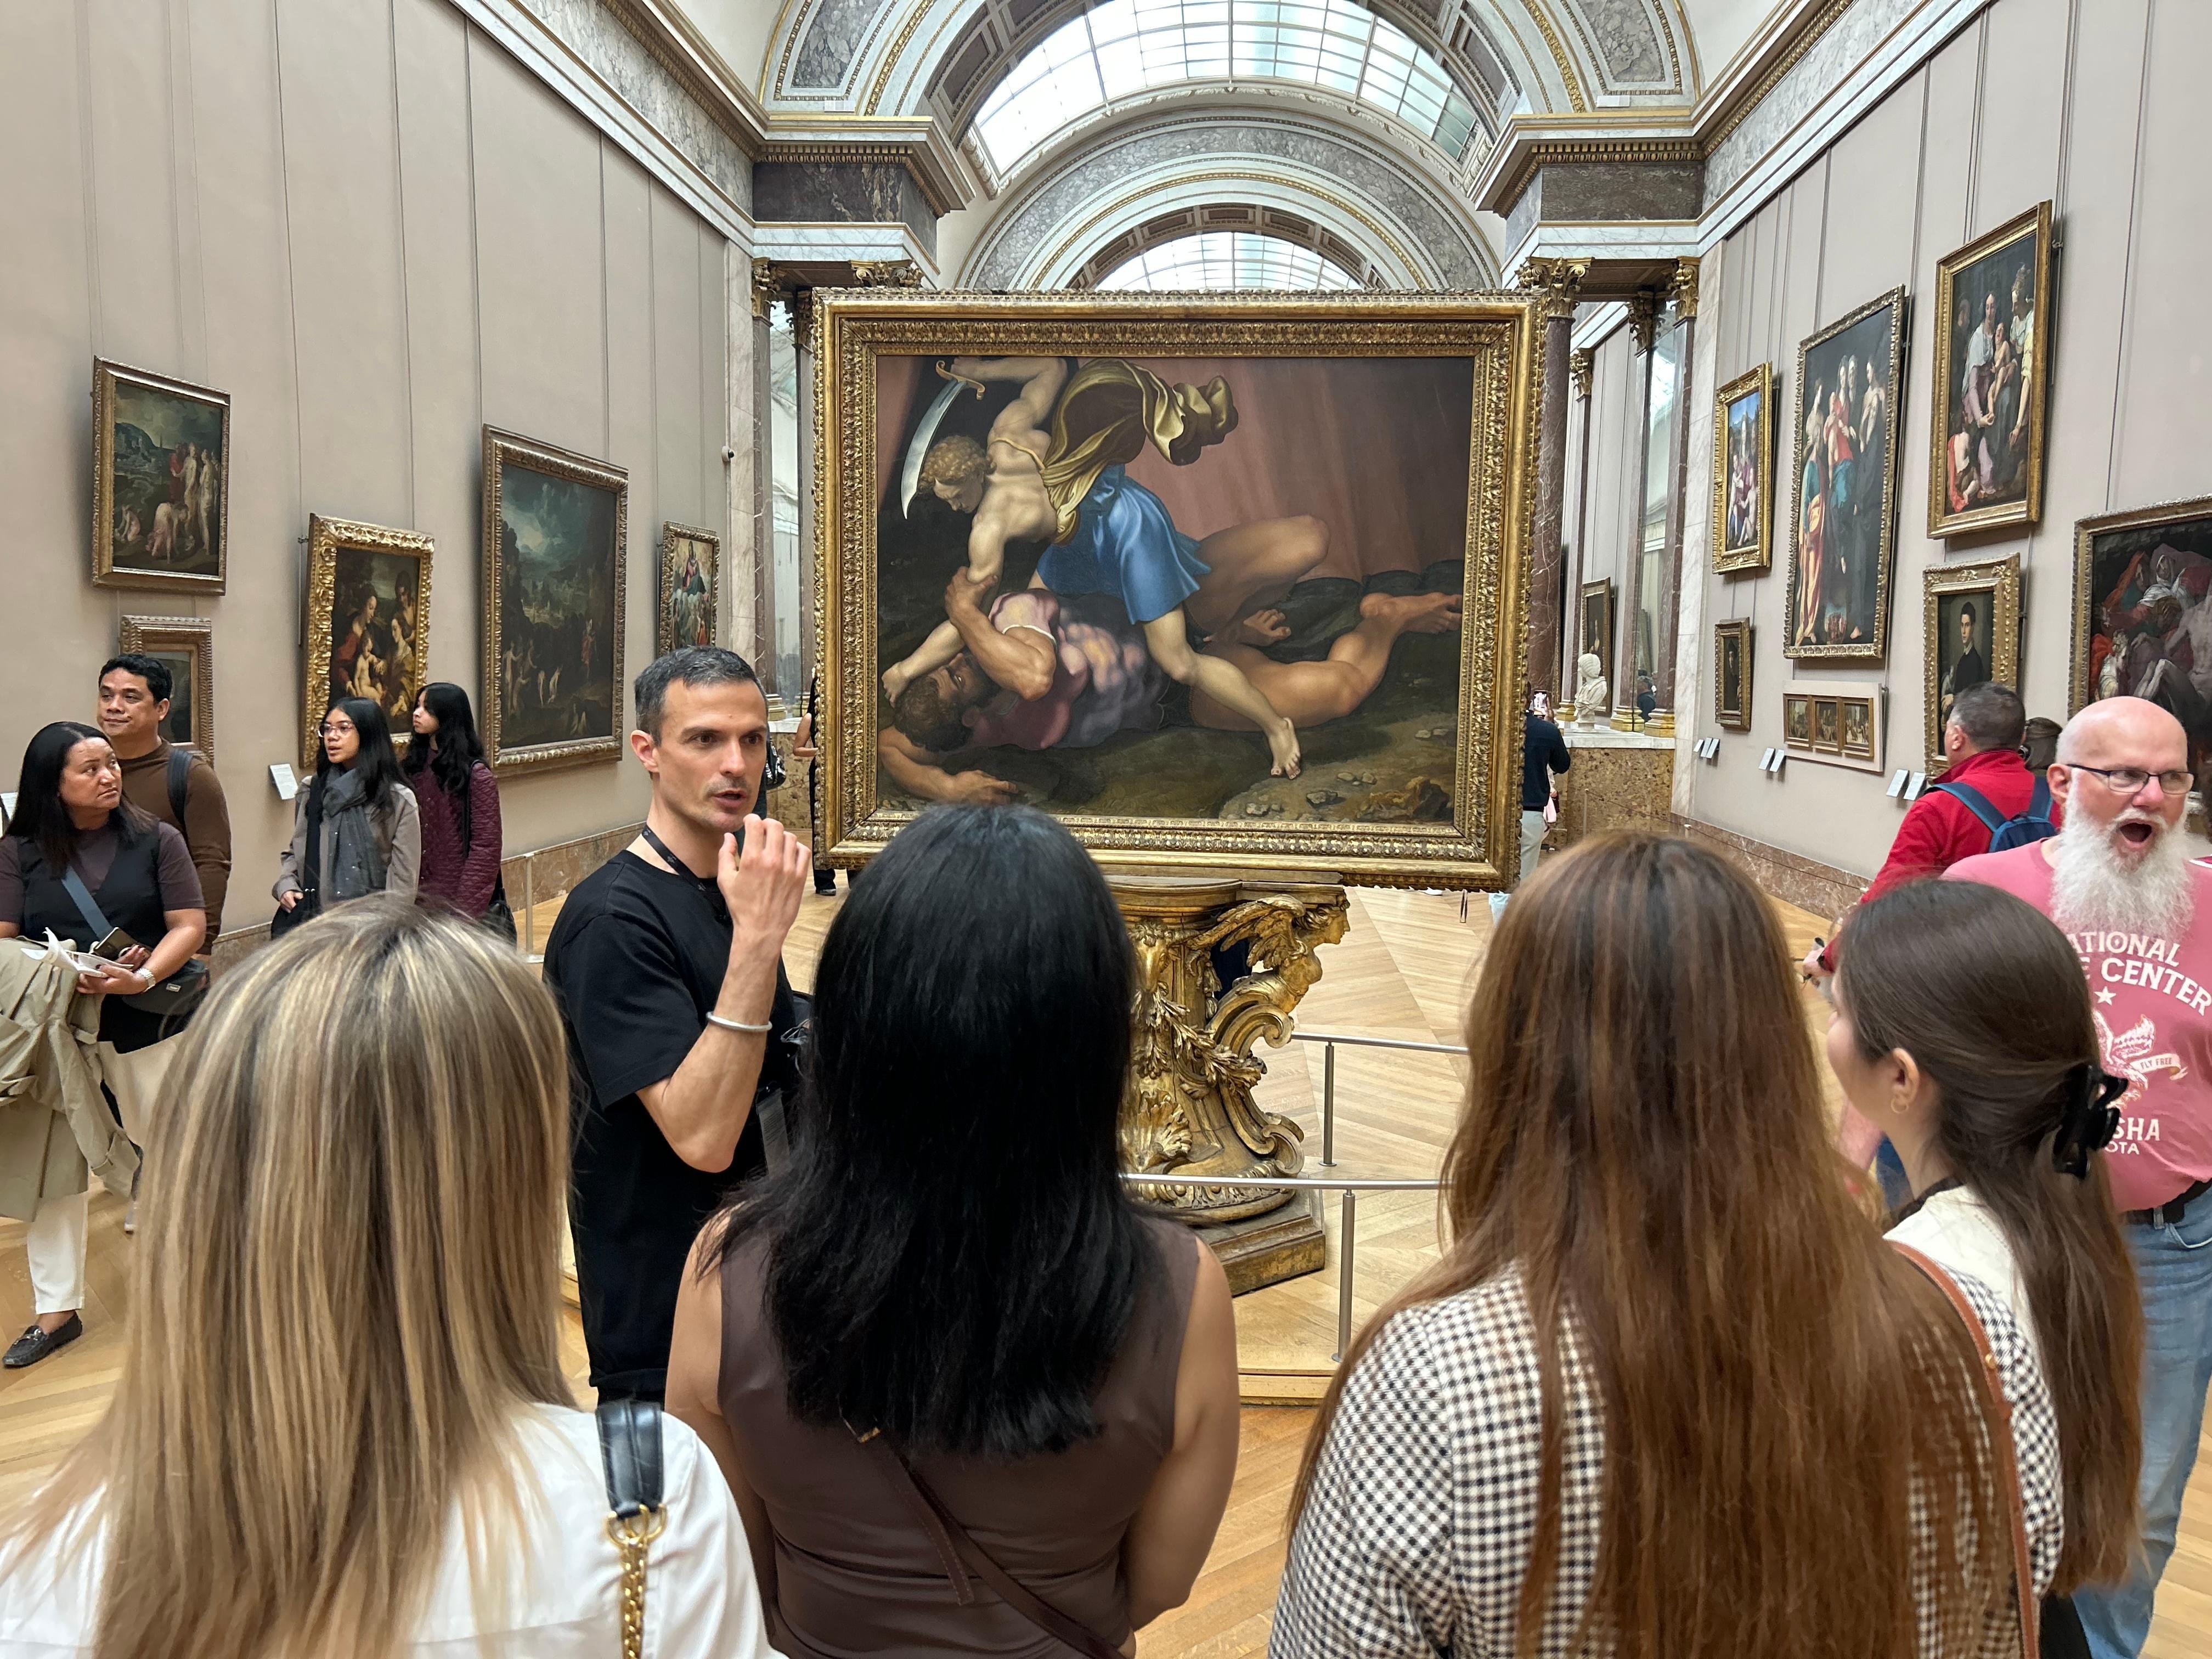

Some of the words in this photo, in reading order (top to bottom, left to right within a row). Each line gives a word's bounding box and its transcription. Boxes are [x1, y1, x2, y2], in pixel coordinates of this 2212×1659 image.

[2101, 957, 2212, 1016] CENTER
[2140, 1060, 2153, 1069] FLY
[2156, 1057, 2172, 1066] FREE
